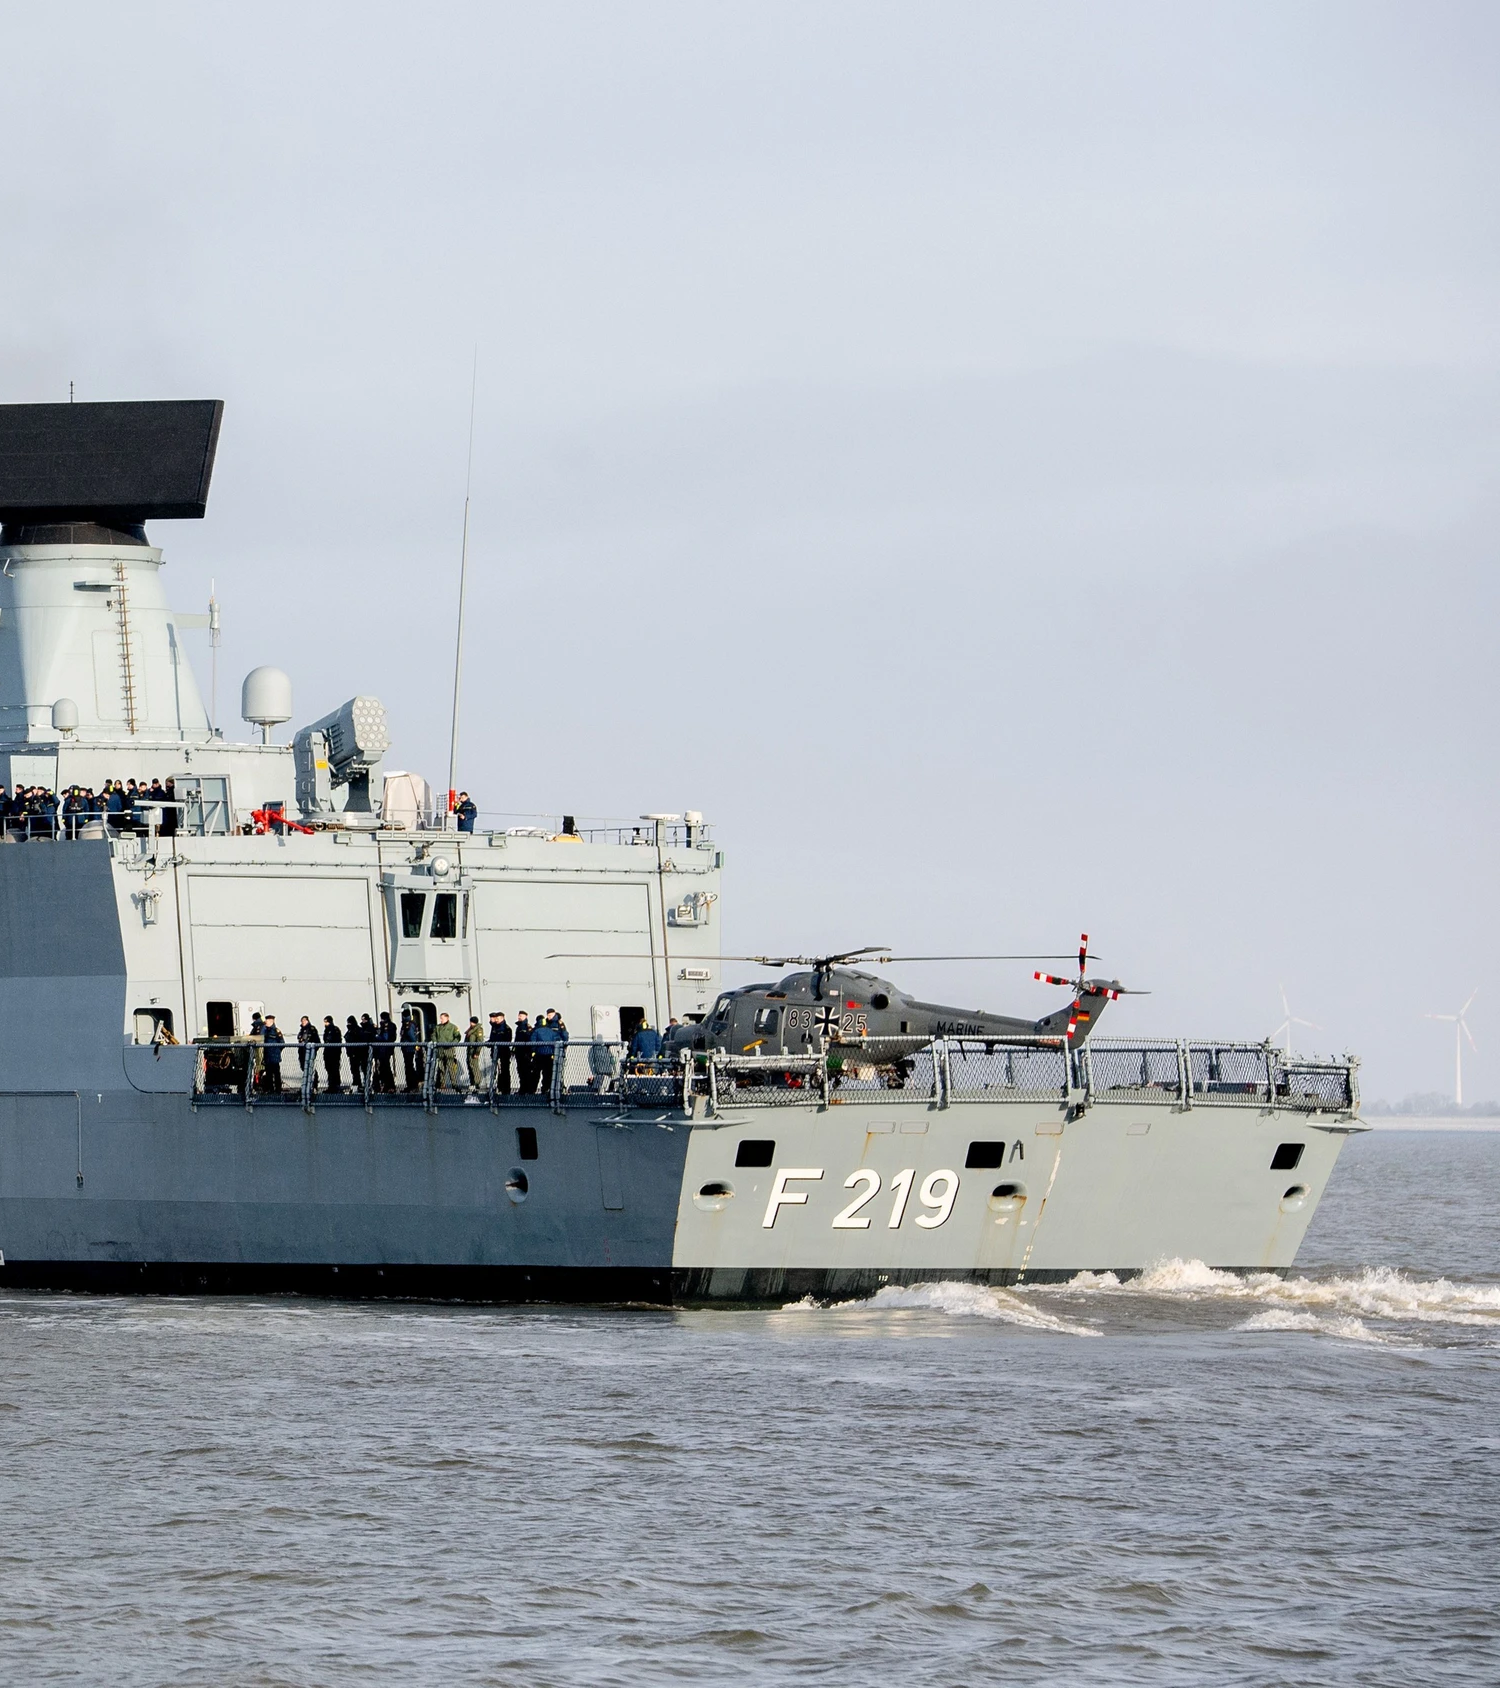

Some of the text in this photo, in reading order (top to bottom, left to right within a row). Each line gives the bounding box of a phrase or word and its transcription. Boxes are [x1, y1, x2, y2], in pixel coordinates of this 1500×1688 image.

[788, 1009, 868, 1034] 83 25
[936, 1020, 985, 1035] MARINE
[762, 1168, 960, 1229] F 219
